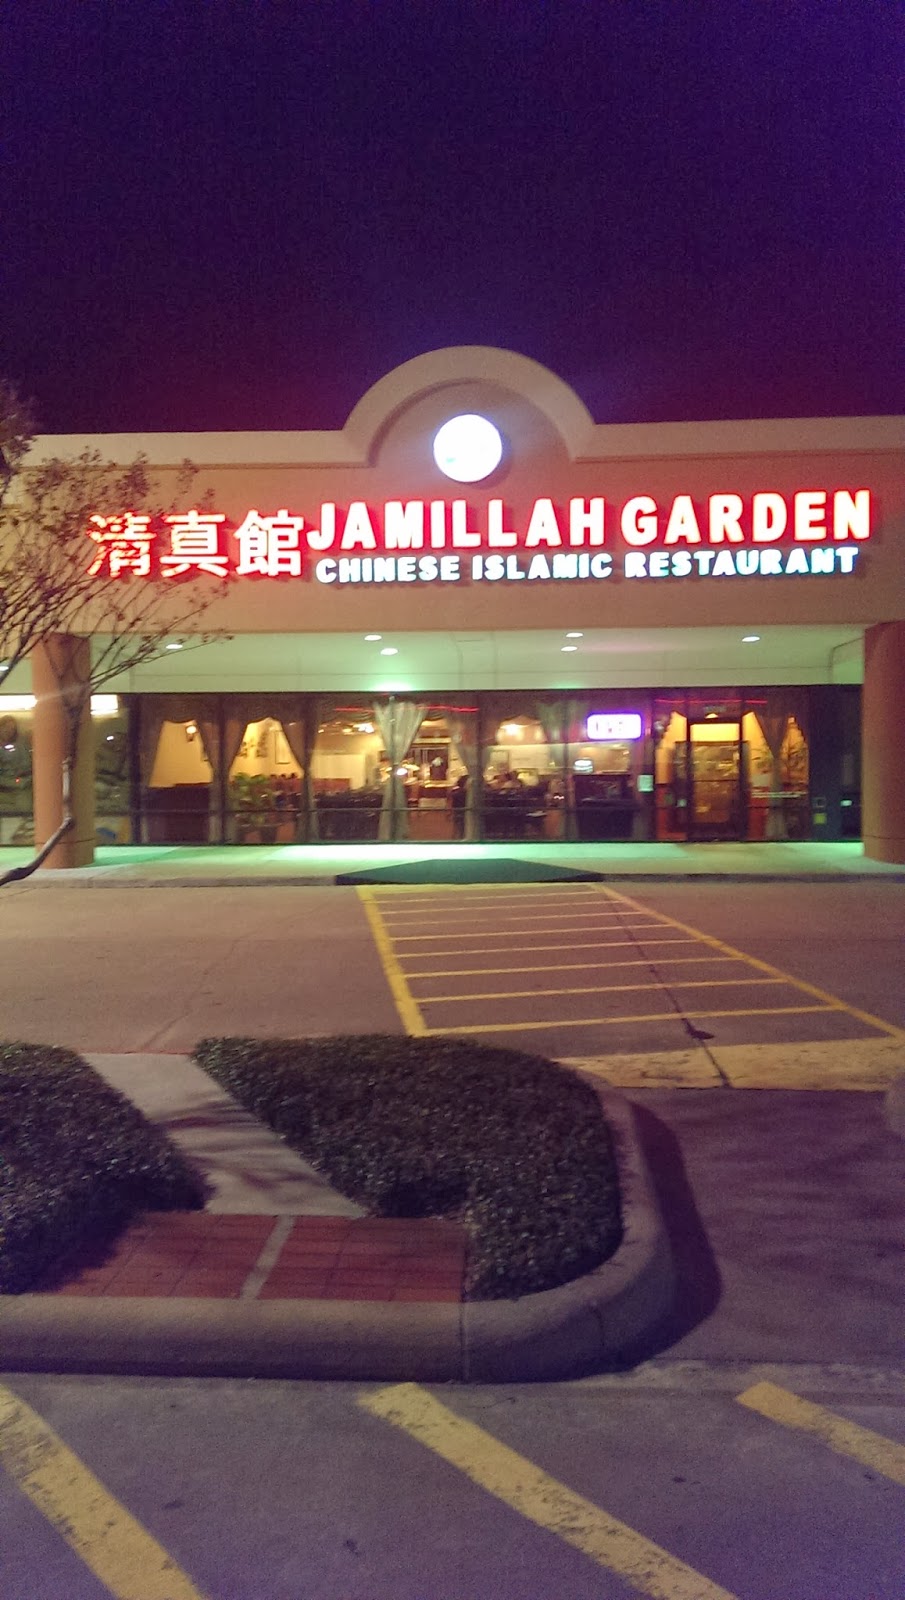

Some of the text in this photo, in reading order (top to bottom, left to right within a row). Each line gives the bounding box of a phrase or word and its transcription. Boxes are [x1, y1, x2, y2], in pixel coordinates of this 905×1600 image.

[87, 510, 304, 578] 清真館
[306, 489, 871, 549] JAMILLAH GARDEN
[315, 546, 859, 584] CHINESE ISLAMIC RESTAURANT
